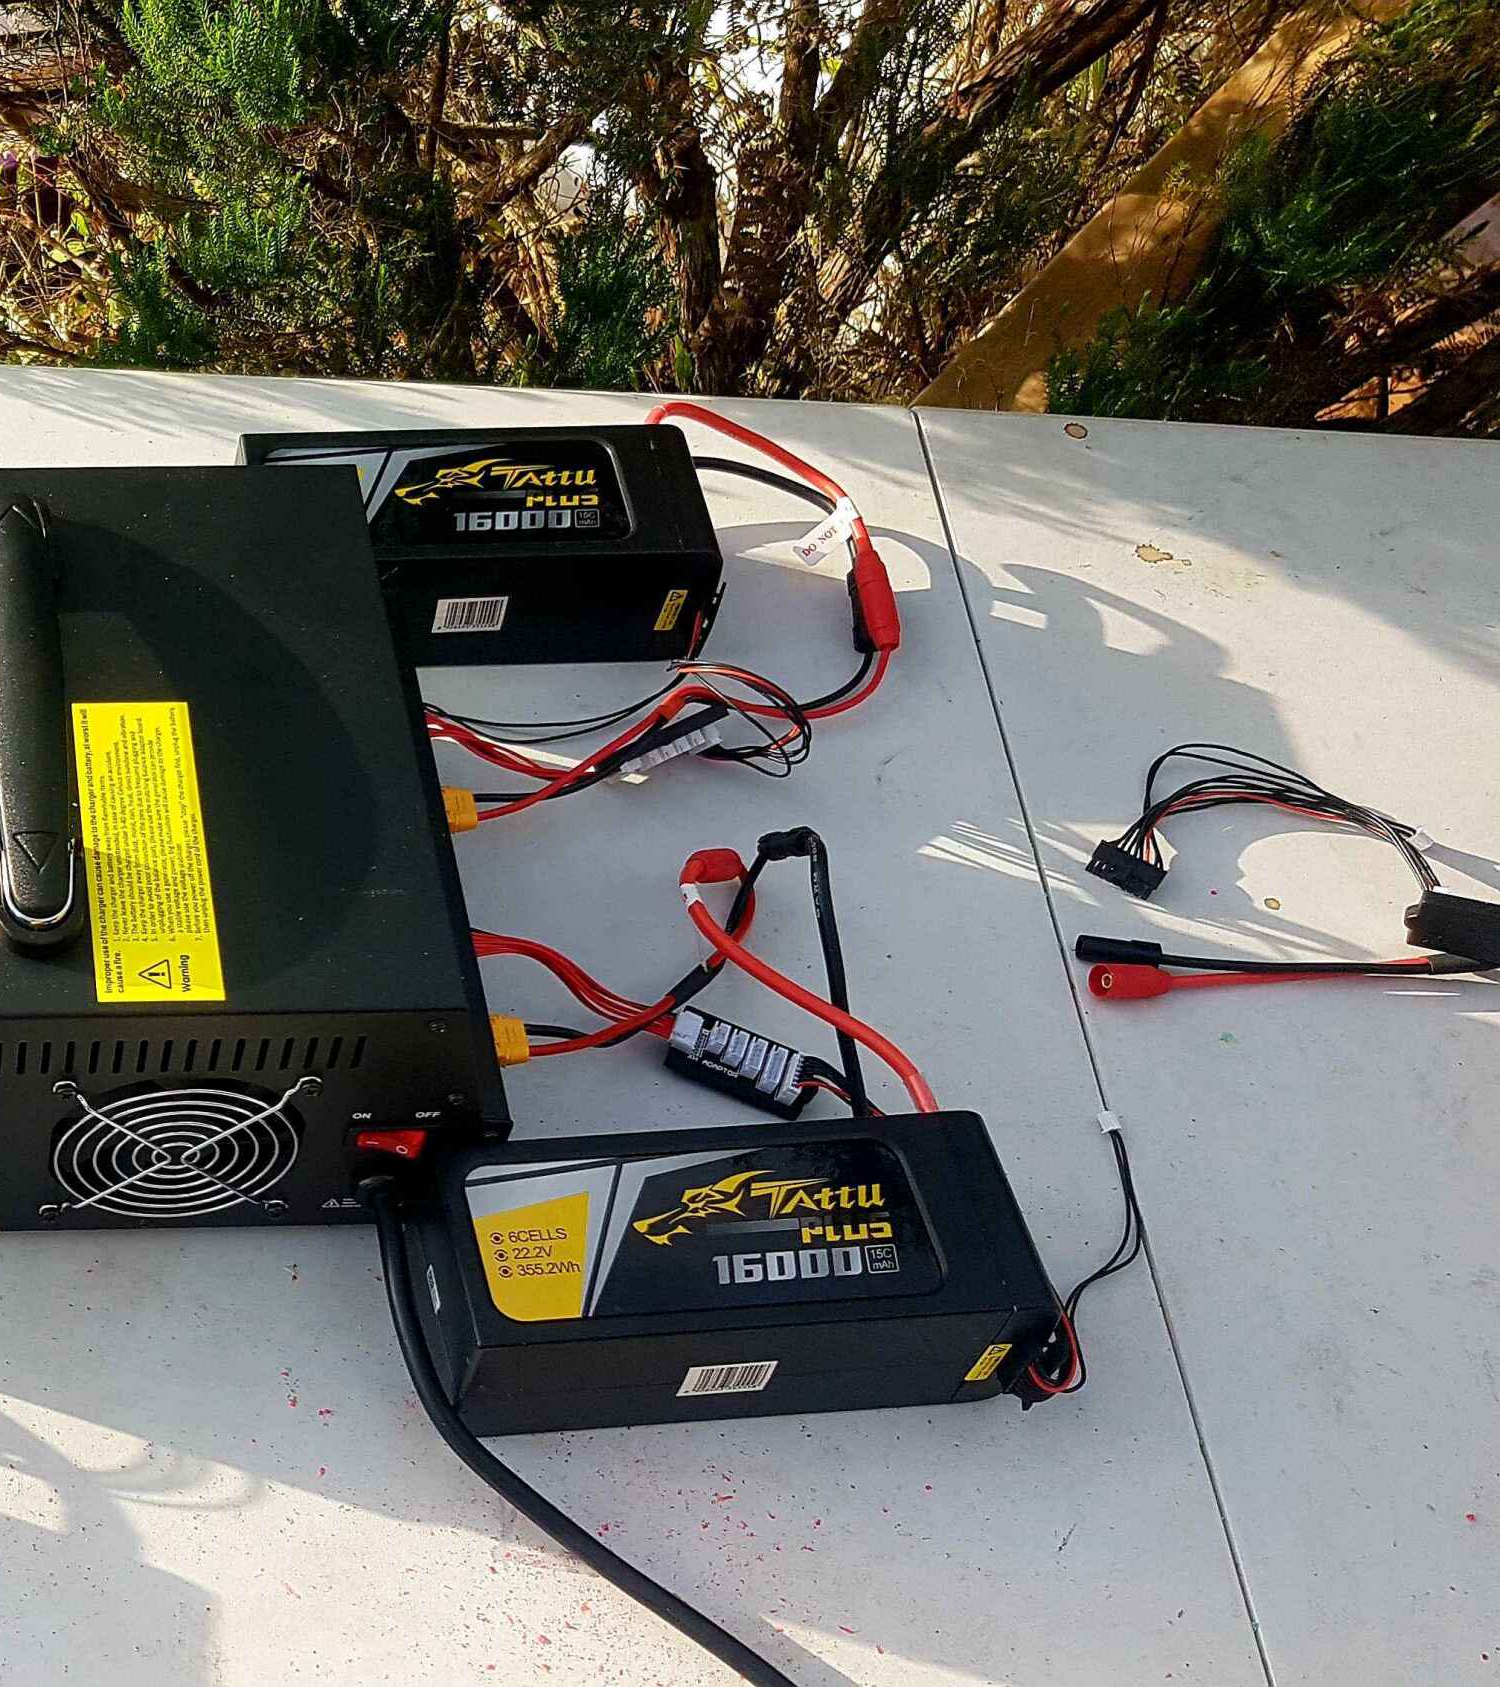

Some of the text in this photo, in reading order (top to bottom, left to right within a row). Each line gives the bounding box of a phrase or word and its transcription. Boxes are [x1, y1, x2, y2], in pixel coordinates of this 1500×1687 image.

[454, 509, 571, 531] 16000
[84, 775, 93, 787] and
[86, 788, 98, 813] charger
[88, 814, 97, 825] the
[94, 861, 102, 881] cause
[95, 896, 108, 923] charger
[98, 924, 107, 935] the
[101, 945, 109, 958] use
[101, 960, 115, 993] Improper
[176, 954, 194, 992] Warning
[116, 970, 124, 992] cause
[352, 1112, 372, 1120] ON
[508, 1228, 567, 1243] 6CELLS
[801, 1213, 892, 1243] PLUS
[512, 1246, 553, 1260] 22.2V
[870, 1249, 892, 1259] 15C
[516, 1261, 580, 1276] 355.2Wh
[712, 1246, 863, 1284] 16000
[873, 1260, 894, 1270] mAh
